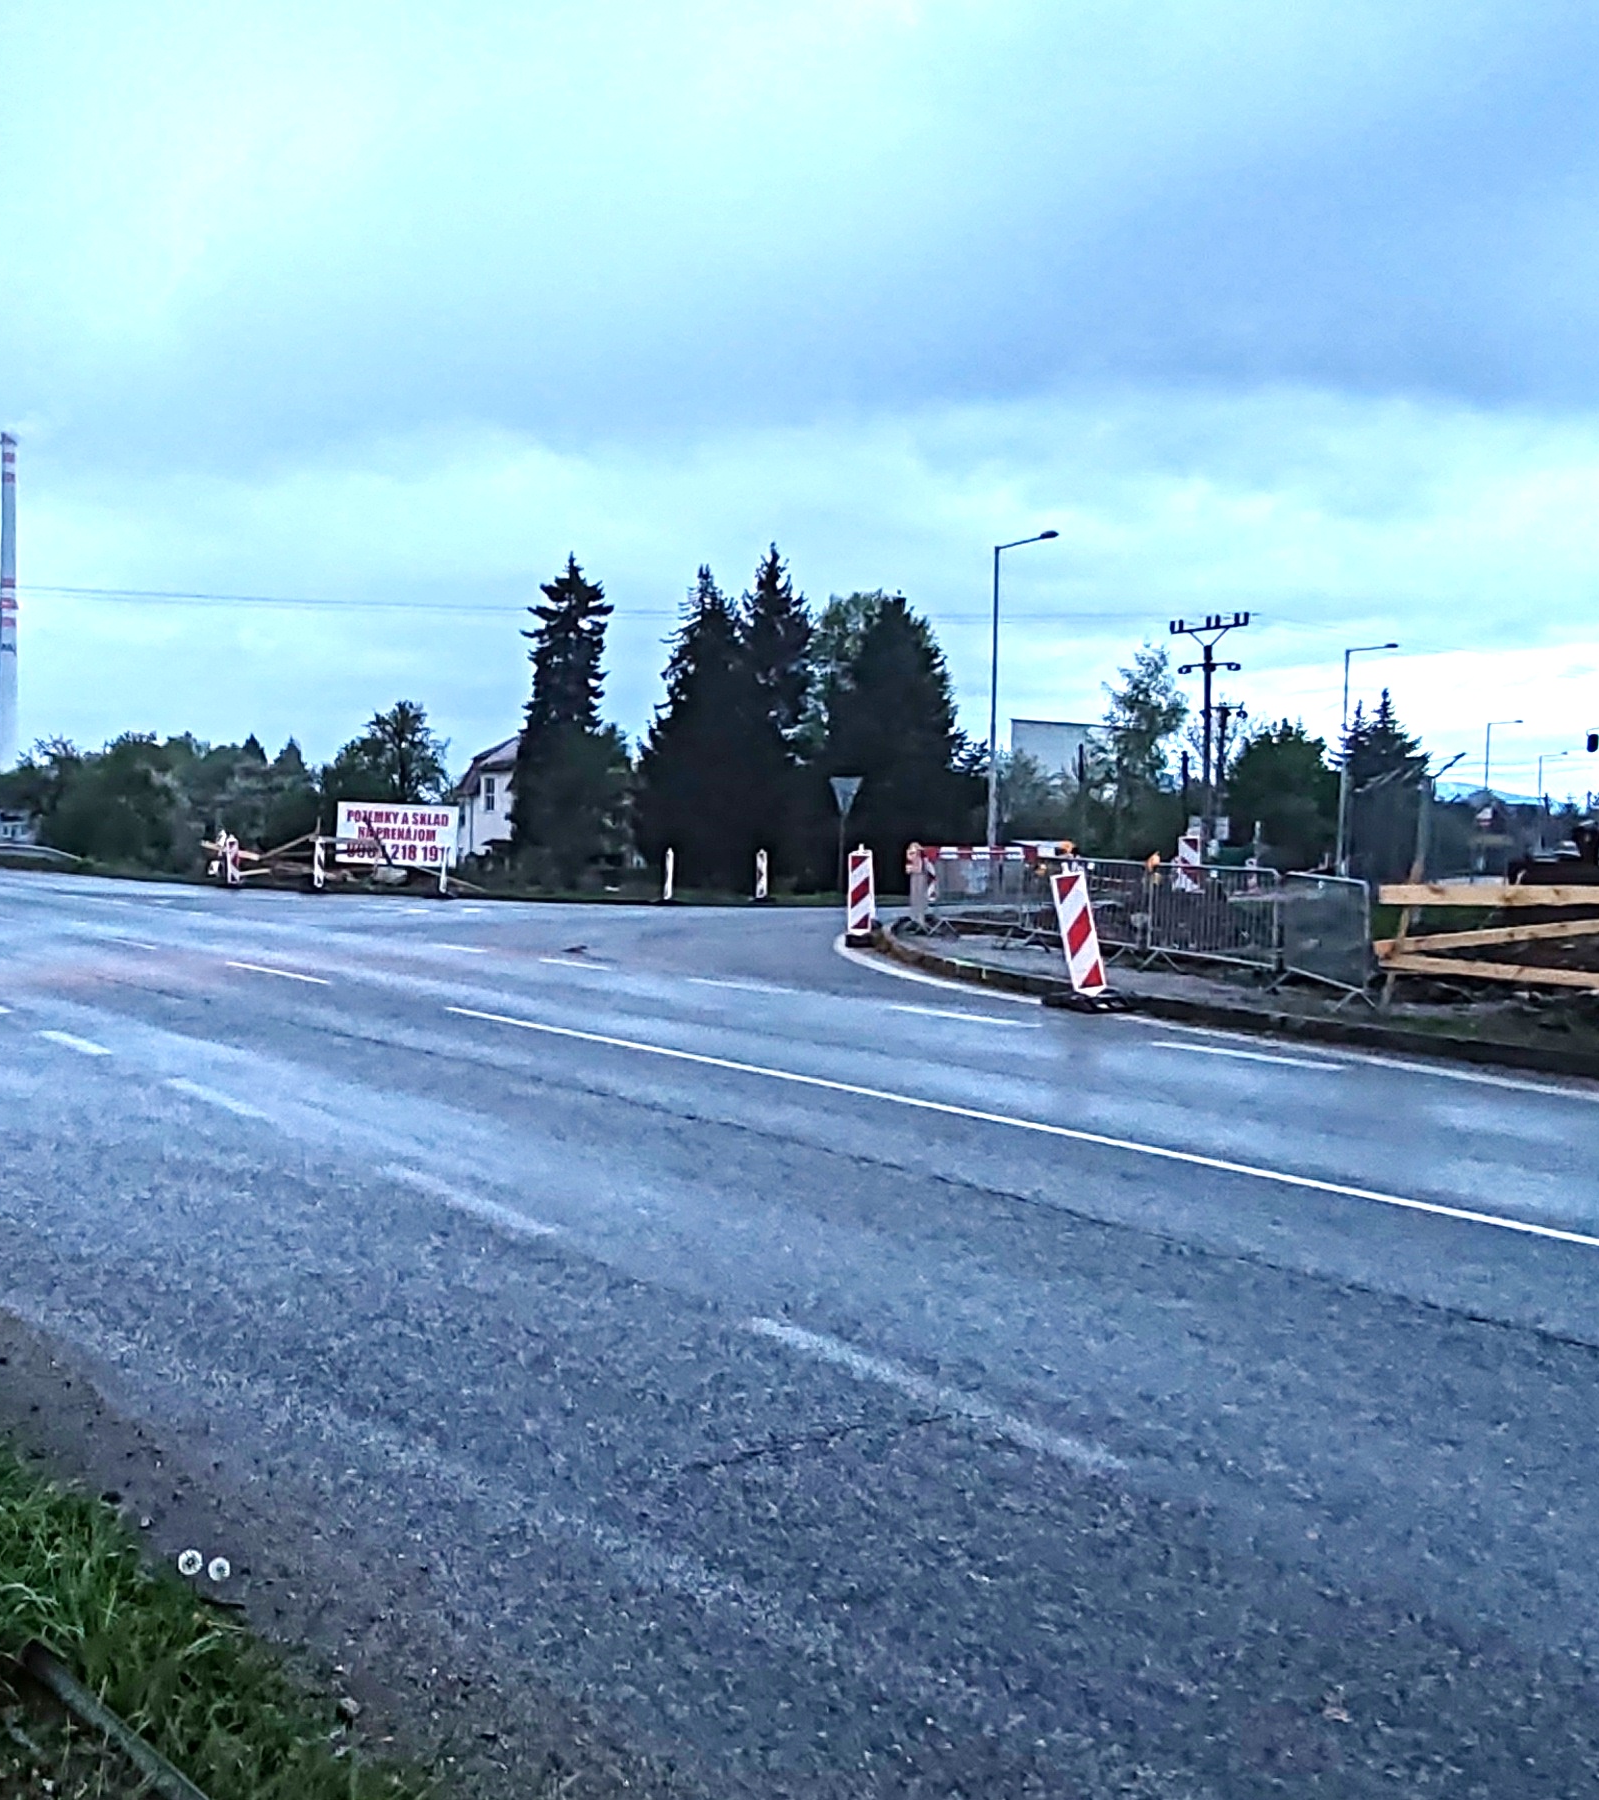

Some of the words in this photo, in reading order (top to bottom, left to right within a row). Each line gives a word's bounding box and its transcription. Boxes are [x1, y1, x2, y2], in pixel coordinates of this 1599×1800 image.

[401, 812, 409, 825] A
[412, 812, 449, 826] SKLAD
[391, 844, 418, 861] 218
